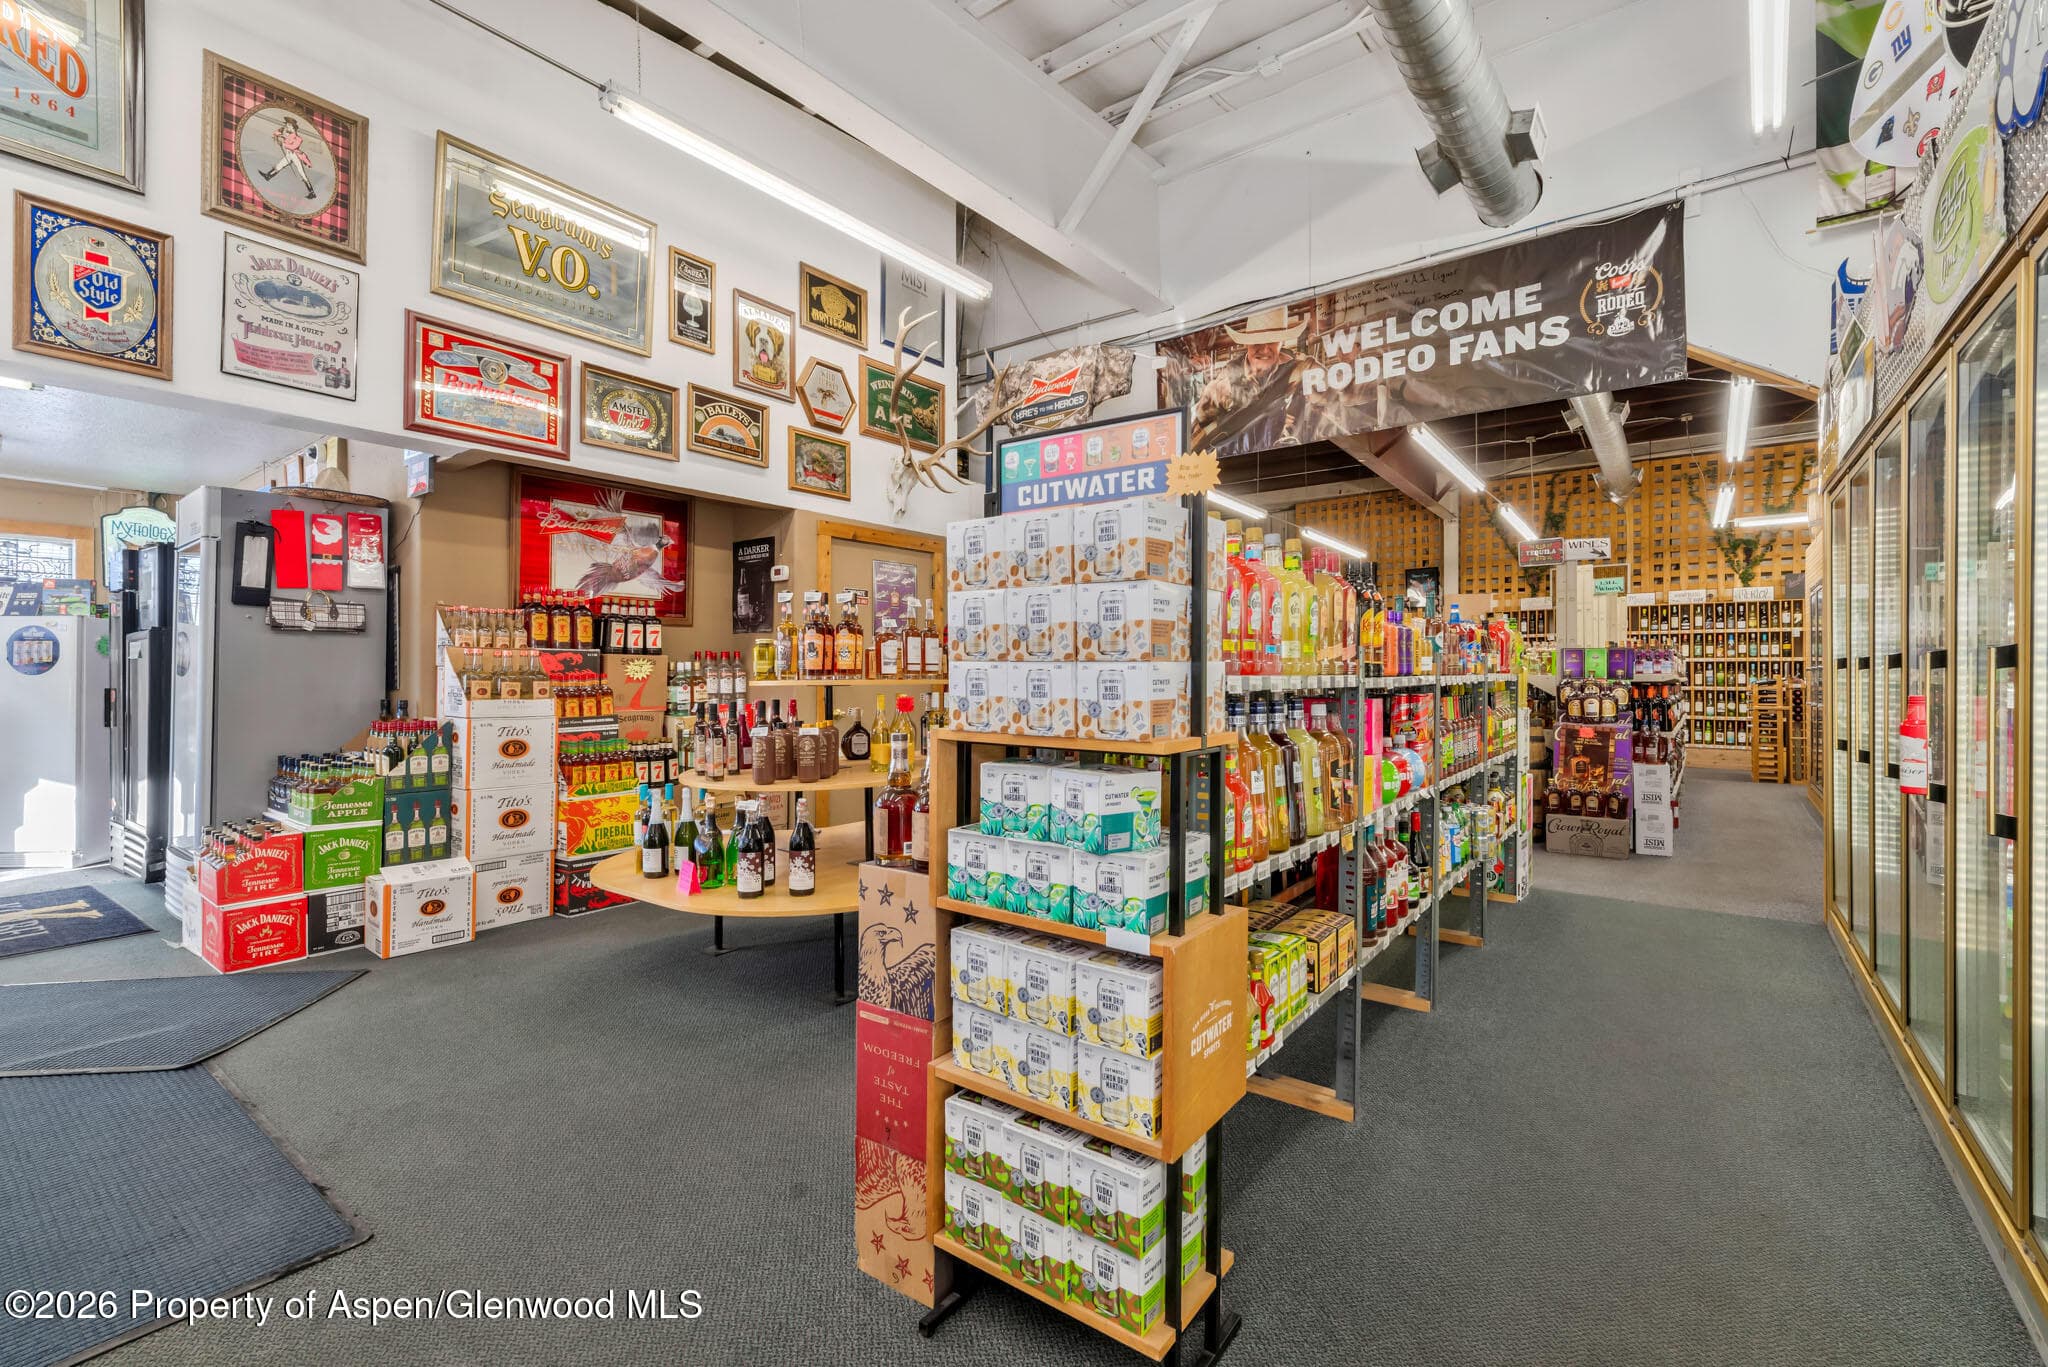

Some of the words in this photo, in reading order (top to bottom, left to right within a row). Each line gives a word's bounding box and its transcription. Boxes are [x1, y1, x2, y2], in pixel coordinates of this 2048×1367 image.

[14, 86, 76, 118] 1864
[489, 191, 614, 259] Seagram's
[508, 224, 600, 299] V.O.
[250, 255, 285, 272] JACK
[286, 257, 339, 293] DANIEL'S
[1595, 258, 1647, 280] Coors
[92, 271, 118, 290] Old
[901, 268, 928, 292] MIST
[79, 279, 119, 305] Style
[1597, 290, 1645, 314] RODEO
[261, 315, 284, 327] MADE
[301, 326, 325, 337] QUIET
[1322, 282, 1543, 359] WELCOME
[1302, 344, 1436, 396] RODEO
[1449, 315, 1571, 366] FANS
[424, 365, 432, 414] GENINE
[870, 379, 917, 405] WEINRD'S
[612, 401, 647, 417] AMSTEL
[1016, 407, 1038, 420] HERE'S
[1054, 395, 1084, 410] HEROES
[708, 405, 750, 427] BAILEYS
[1018, 467, 1155, 507] CUTWATER
[537, 512, 623, 534] Budweiser
[111, 520, 176, 541] MYTHOLOGY
[744, 544, 769, 555] DARKER
[1568, 540, 1608, 549] WINES
[1526, 548, 1557, 556] TEQUILA
[615, 628, 624, 646] 7
[631, 629, 641, 646] 7
[649, 630, 660, 646] 7
[497, 725, 532, 737] Tito's
[492, 759, 536, 769] Handmade
[672, 763, 678, 777] 7
[639, 766, 647, 780] 7
[653, 765, 662, 779] 7
[497, 796, 532, 808] Tito's
[1105, 791, 1129, 800] CUTWATER
[1641, 793, 1662, 801] MIST
[323, 801, 373, 810] Tennessee
[327, 809, 368, 818] APPLE
[492, 828, 536, 841] Handmade
[594, 823, 634, 842] FIREBALL
[1548, 818, 1584, 834] Crown
[1587, 819, 1625, 840] Royal
[318, 840, 338, 855] JACK
[340, 837, 370, 851] DANIEL'S
[1643, 838, 1665, 847] MIST
[232, 851, 253, 867] JACK
[254, 848, 290, 861] DANIEL'S
[242, 877, 280, 887] Tennessee
[328, 871, 361, 880] APPLE
[247, 884, 276, 893] FIRE
[417, 886, 450, 899] Tito's
[236, 918, 260, 934] JACK
[260, 914, 295, 926] DANIEL'S
[411, 915, 453, 928] Handmade
[247, 942, 284, 953] Tennessee
[252, 950, 280, 959] FIRE
[971, 965, 984, 973] MARTIN
[1030, 982, 1044, 991] MARTIN
[1102, 1002, 1119, 1012] MARTIN
[974, 1033, 988, 1041] MARTIN
[1190, 1010, 1234, 1058] CUTWATER
[863, 1042, 920, 1068] FREEDOM
[1203, 1039, 1221, 1060] SPIRITS
[1031, 1056, 1046, 1065] MARTIN
[873, 1076, 910, 1096] TASTE
[1106, 1082, 1124, 1092] MARTIN
[879, 1093, 903, 1110] THE
[967, 1130, 981, 1140] VODKA
[968, 1138, 980, 1148] MULE
[1025, 1158, 1040, 1169] VODKA
[1025, 1166, 1038, 1177] MULE
[1095, 1184, 1113, 1197] VODKA
[966, 1200, 980, 1211] VODKA
[1097, 1193, 1111, 1206] MULE
[966, 1208, 979, 1219] MULE
[1024, 1231, 1040, 1243] VODKA
[1025, 1239, 1038, 1251] MULE
[1097, 1260, 1114, 1274] VODKA
[1099, 1269, 1113, 1282] MULE
